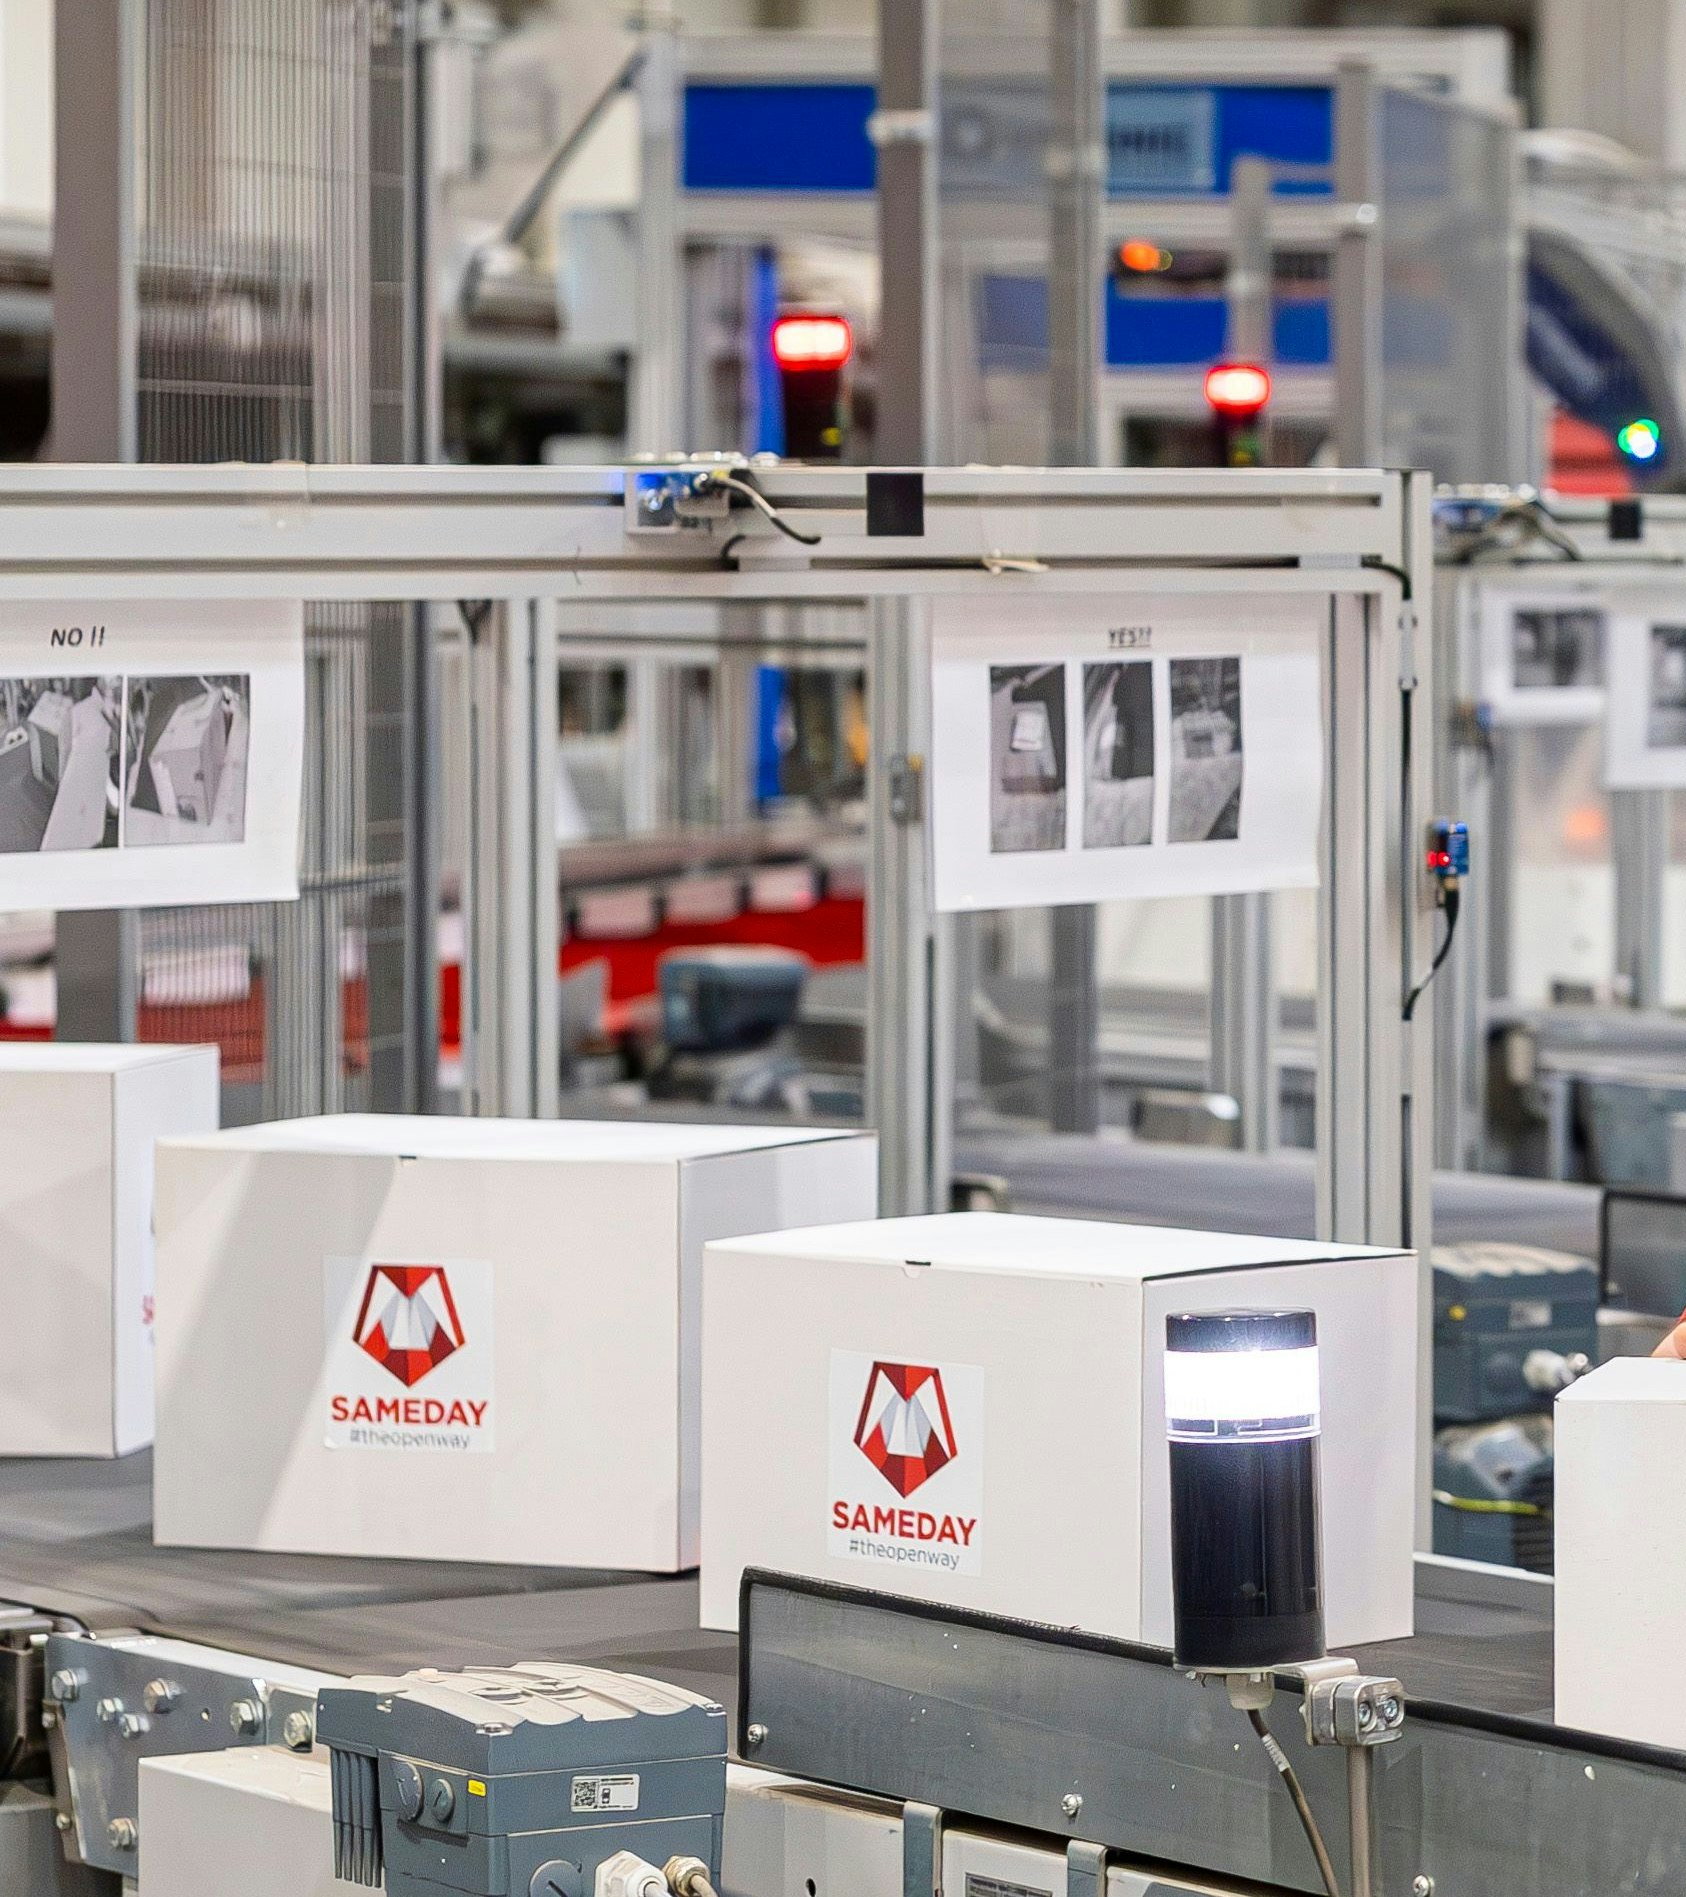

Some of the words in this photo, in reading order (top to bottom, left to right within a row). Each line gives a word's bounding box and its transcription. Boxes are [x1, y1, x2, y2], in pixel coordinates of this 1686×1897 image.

[50, 627, 83, 647] NO
[331, 1396, 488, 1426] SAMEDAY
[350, 1427, 471, 1449] #theopenway
[832, 1501, 977, 1546] SAMEDAY
[849, 1538, 960, 1571] #theopenway
